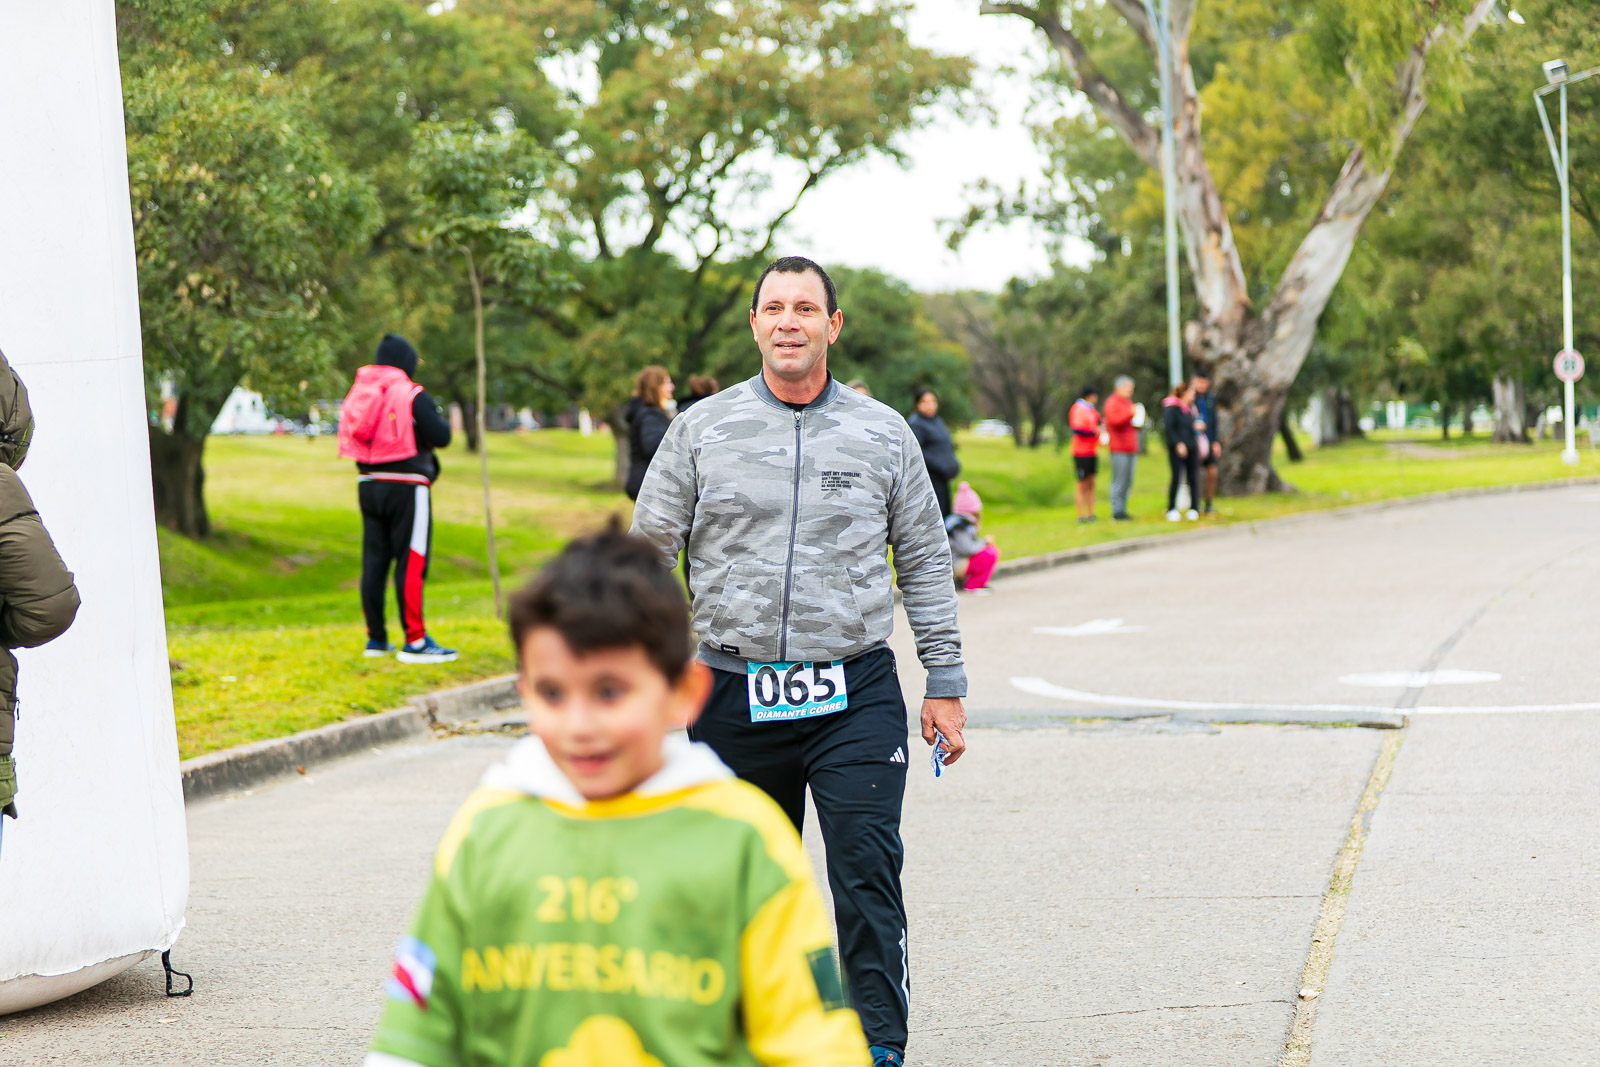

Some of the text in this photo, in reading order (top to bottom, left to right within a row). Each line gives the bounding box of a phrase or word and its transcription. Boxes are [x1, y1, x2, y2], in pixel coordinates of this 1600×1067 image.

[755, 661, 836, 707] 065
[756, 701, 842, 720] DIAMANTE CORRE
[460, 942, 726, 1006] ANIVERSARIO
